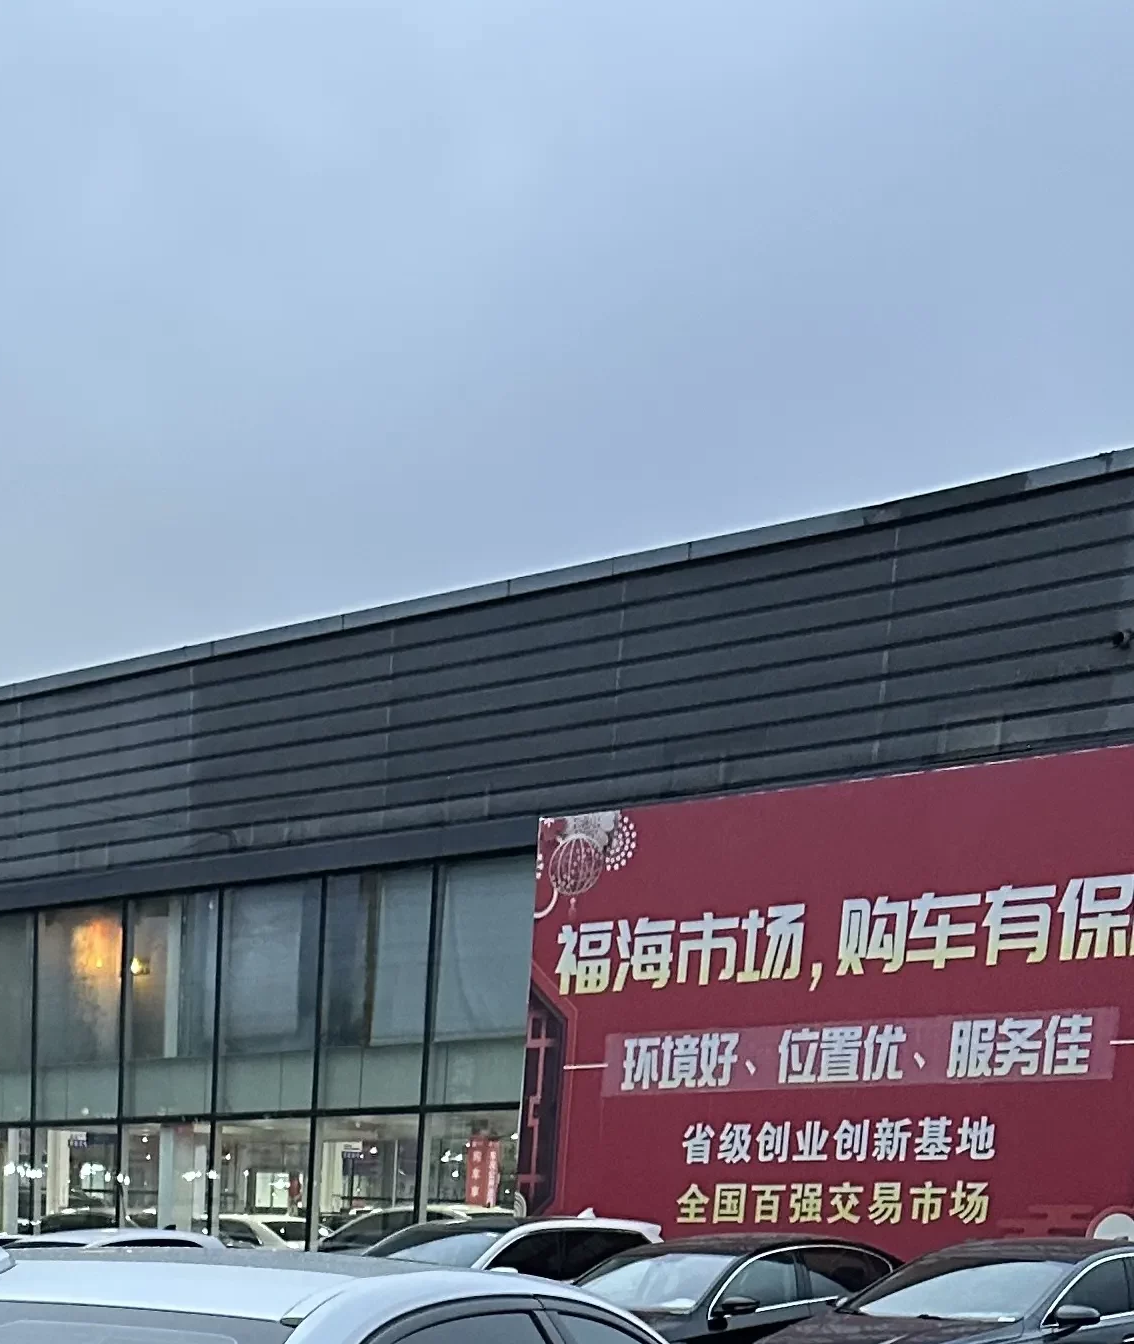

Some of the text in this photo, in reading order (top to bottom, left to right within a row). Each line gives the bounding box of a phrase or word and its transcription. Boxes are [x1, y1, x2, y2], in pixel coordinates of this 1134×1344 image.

[553, 872, 1134, 996] 福海市场，购车有保
[680, 1115, 997, 1165] 省级创业创新基地
[675, 1181, 990, 1226] 全国百强交易市场
